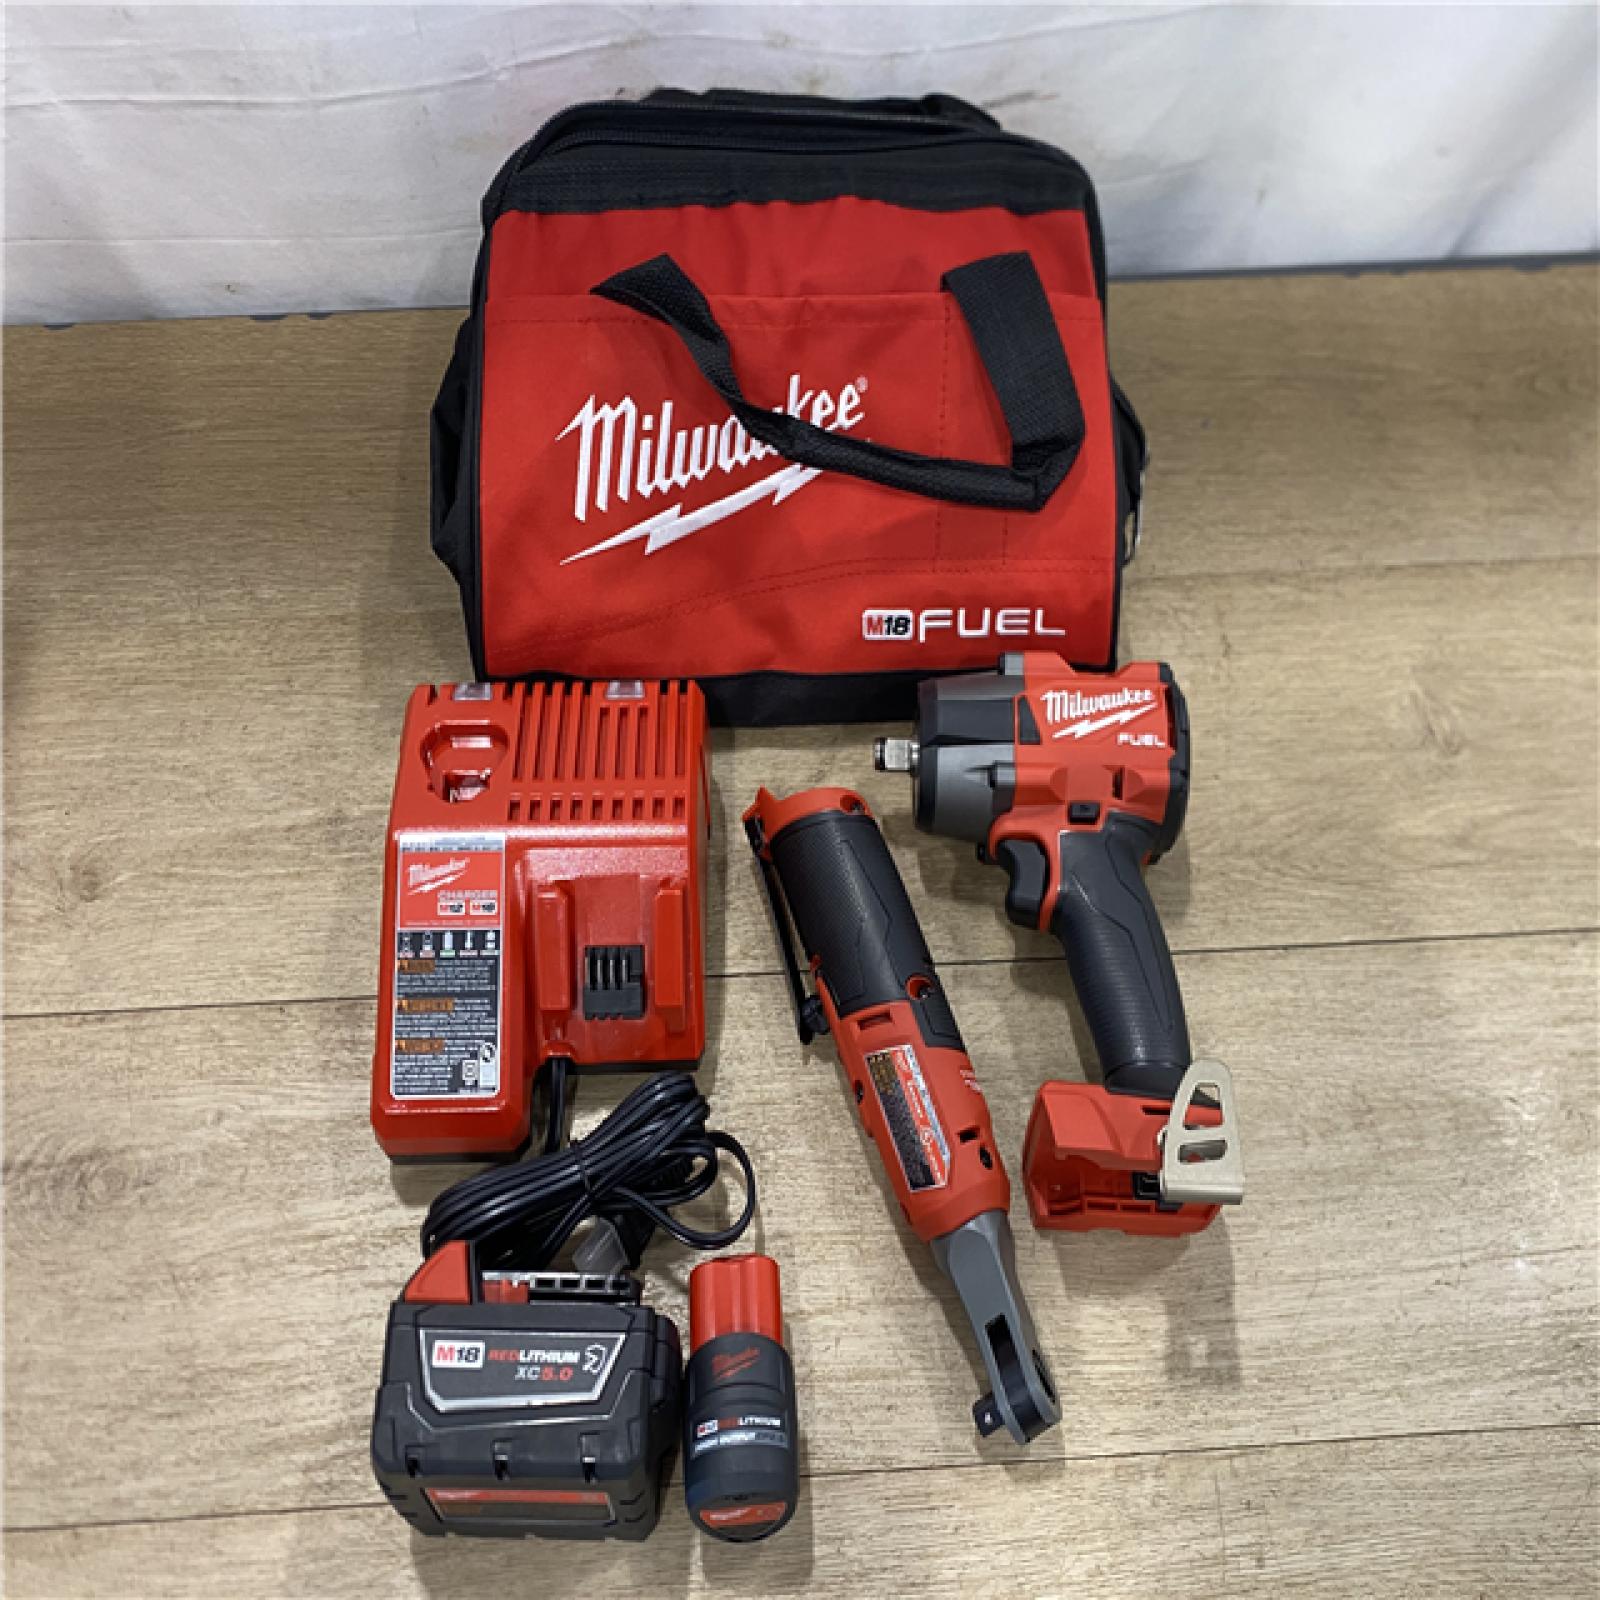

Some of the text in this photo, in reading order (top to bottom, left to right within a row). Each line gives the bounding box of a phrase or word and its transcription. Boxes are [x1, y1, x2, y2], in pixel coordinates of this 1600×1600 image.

[865, 607, 1066, 643] M18 FUEL
[1040, 688, 1153, 726] Milwaukee
[1117, 731, 1166, 748] FUEL
[434, 1344, 482, 1362] M18
